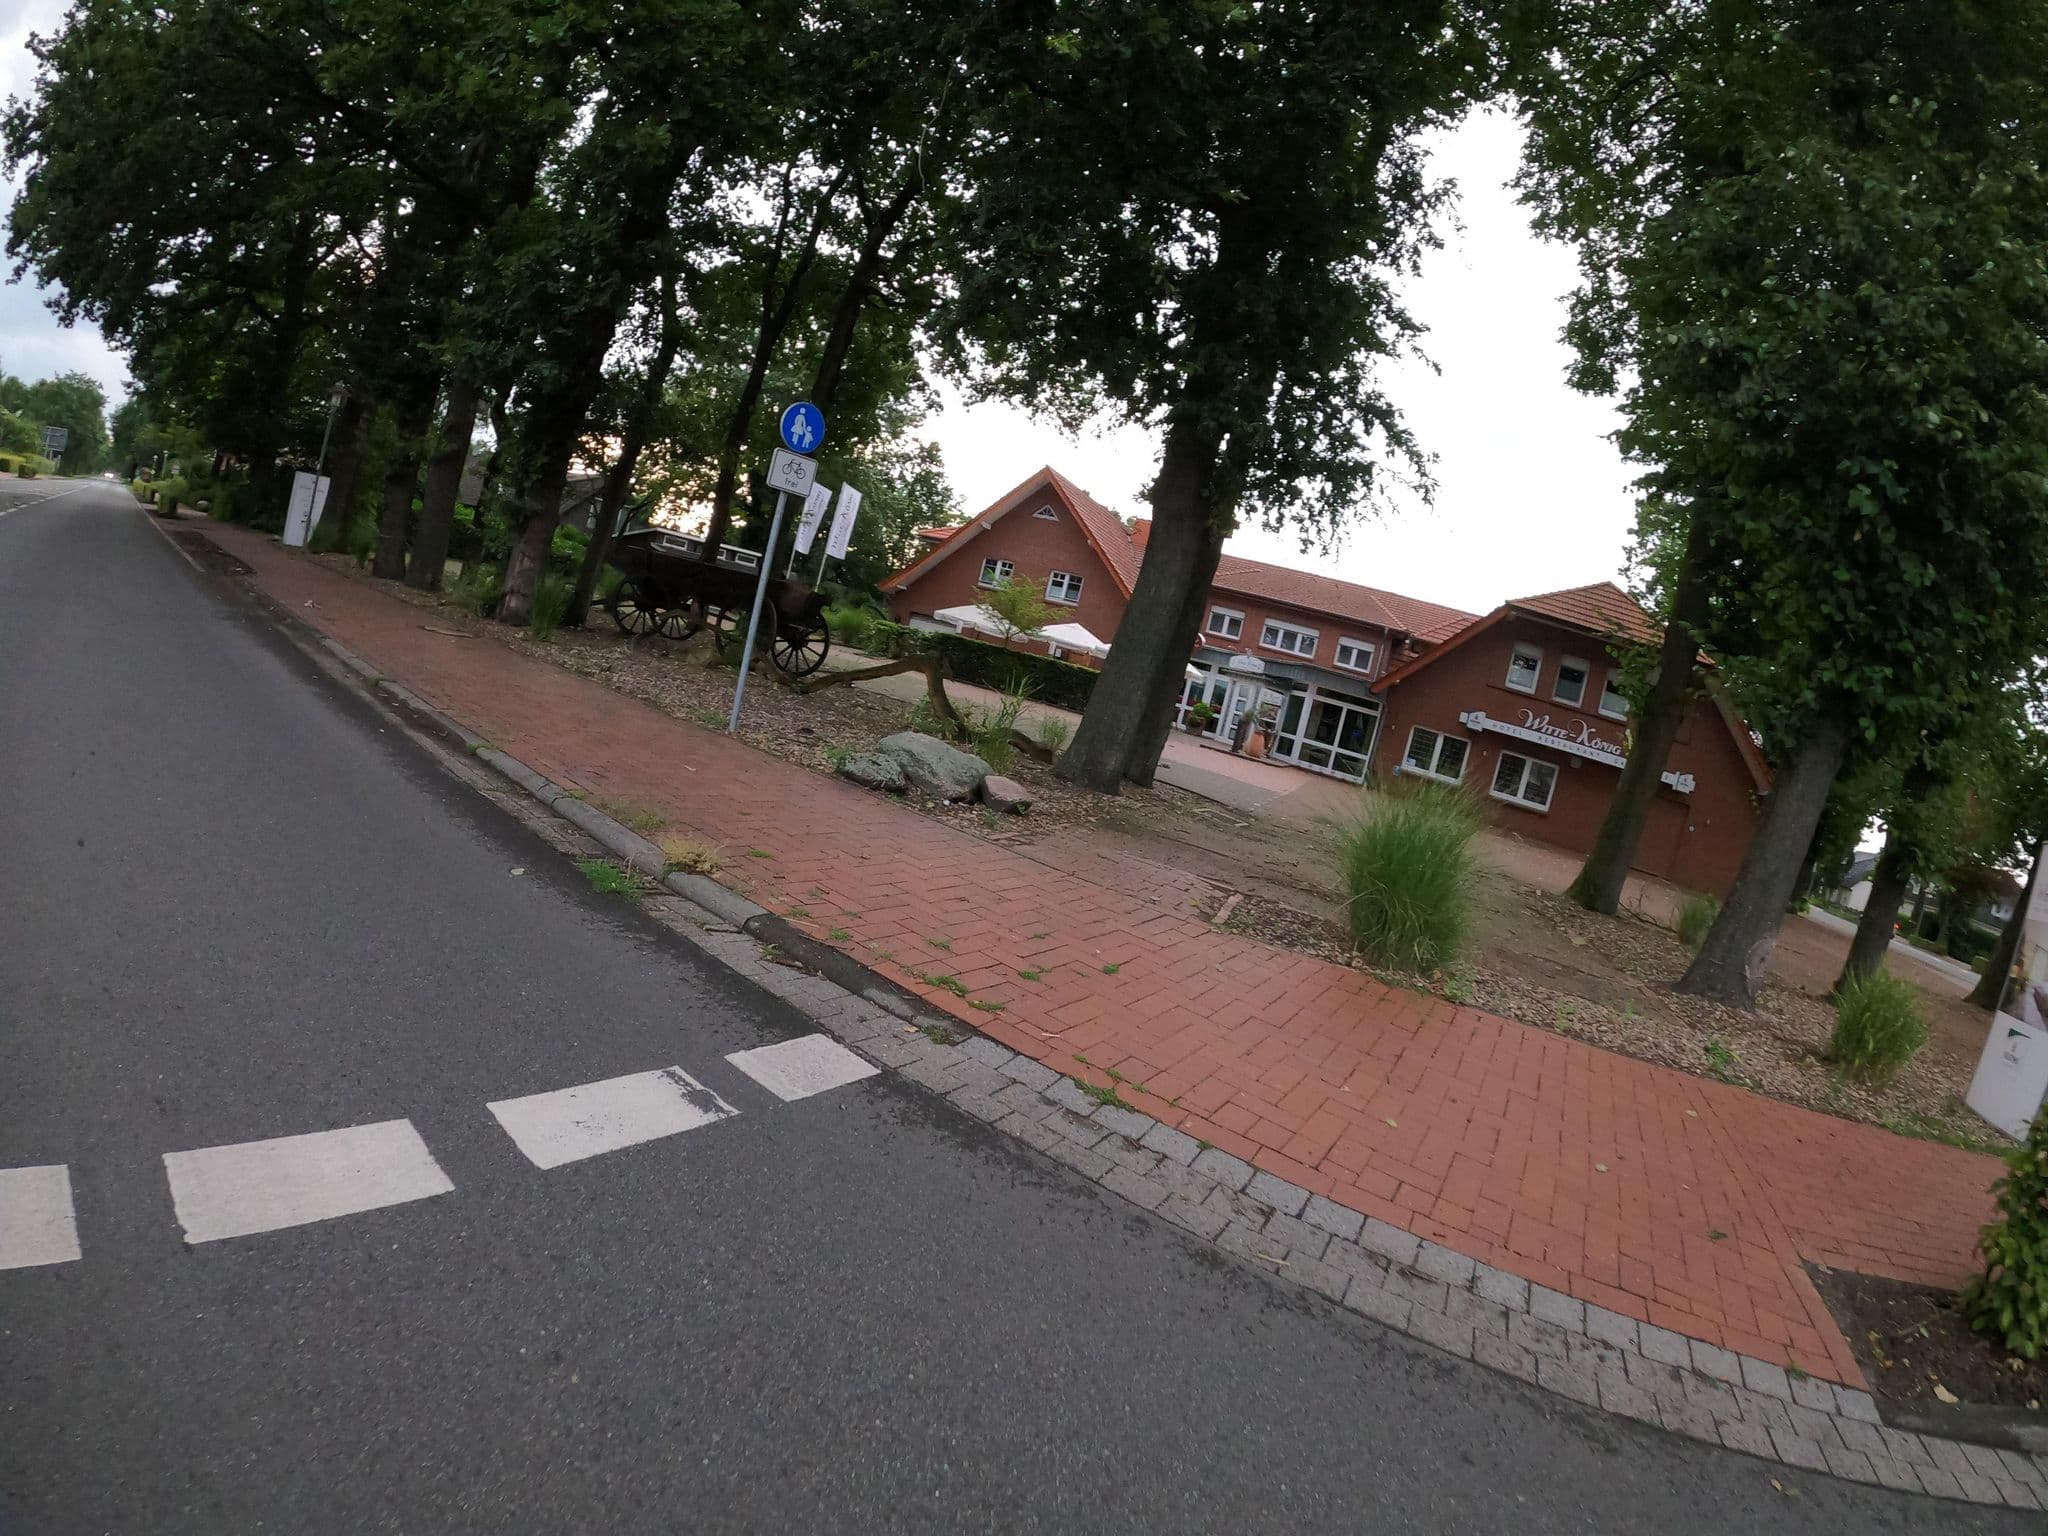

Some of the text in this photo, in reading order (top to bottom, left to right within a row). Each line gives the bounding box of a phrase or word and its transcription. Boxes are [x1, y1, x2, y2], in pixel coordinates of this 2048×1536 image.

[784, 477, 799, 489] frei
[1493, 723, 1603, 757] HOTEL RESTAURANT
